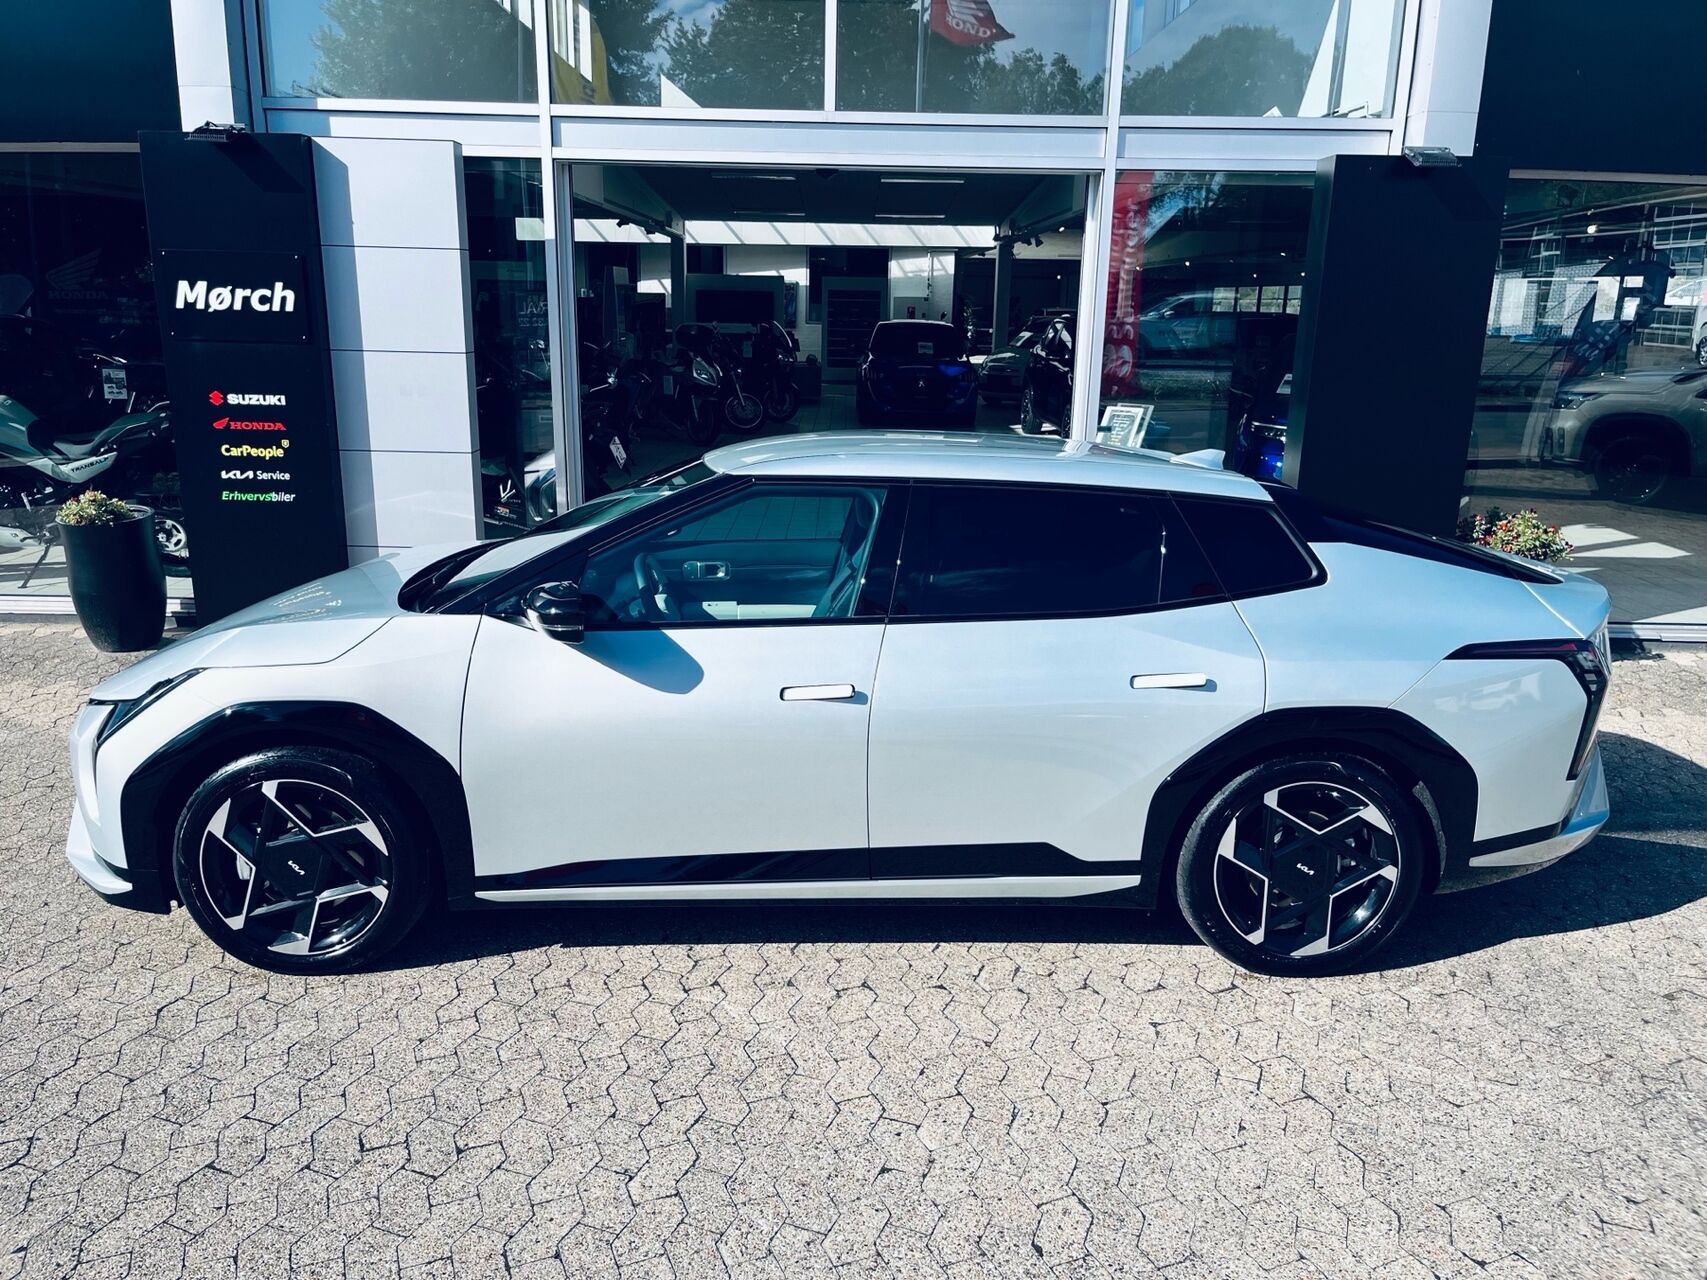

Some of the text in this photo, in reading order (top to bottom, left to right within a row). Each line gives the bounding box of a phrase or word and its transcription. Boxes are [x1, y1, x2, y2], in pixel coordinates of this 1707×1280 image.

[175, 279, 296, 312] Mørch
[226, 393, 287, 406] SUZUKI
[228, 421, 287, 431] HONDA
[220, 444, 285, 460] CarPeople
[71, 457, 109, 472] TRANSALP
[220, 470, 291, 481] KIA Service
[221, 491, 297, 502] Erhvervsbiler
